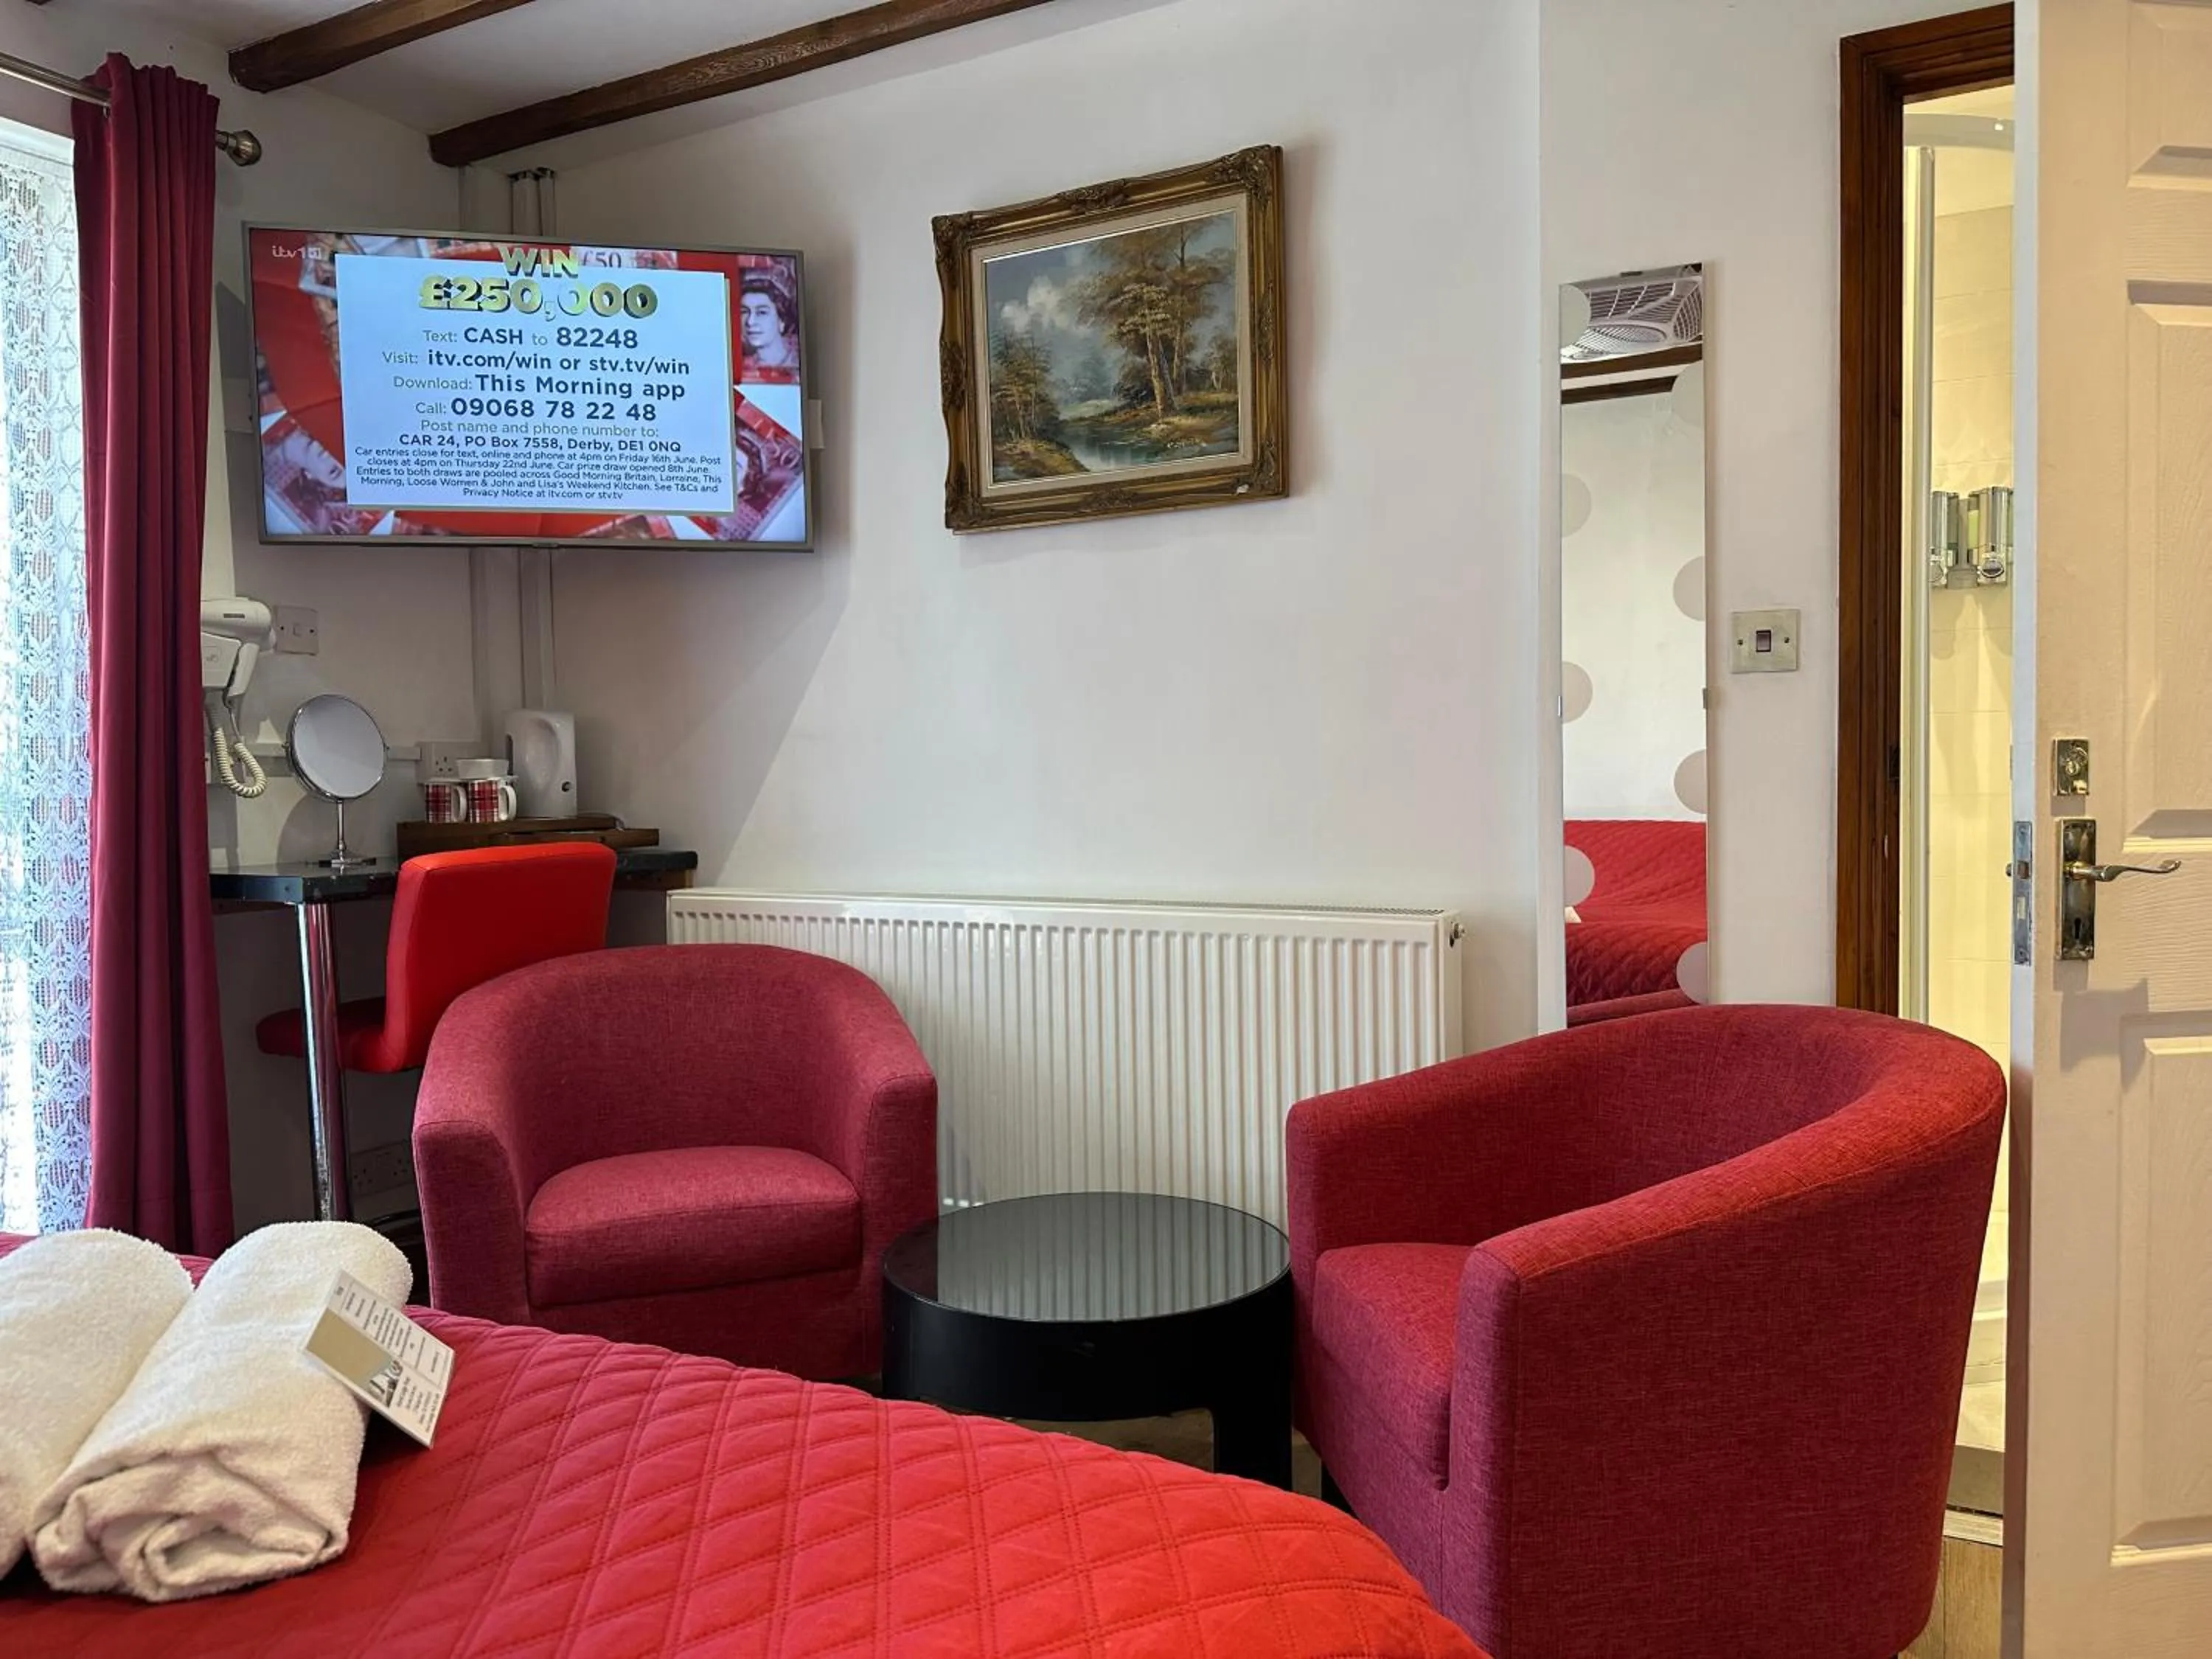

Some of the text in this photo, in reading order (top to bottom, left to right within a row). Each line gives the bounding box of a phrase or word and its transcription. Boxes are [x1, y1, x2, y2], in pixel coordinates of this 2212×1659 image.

[497, 246, 579, 278] WIN
[423, 327, 639, 349] Text: CASH to 82248
[382, 349, 690, 375] Visit: itv.com/win or stv.tv/win
[393, 374, 686, 400] Download: This Morning app
[415, 397, 656, 421] Call: 09068 78 22 48
[421, 420, 659, 437] Post name and phone number to:
[399, 434, 432, 445] CAR
[437, 435, 459, 448] 24,
[465, 436, 486, 447] PO
[490, 437, 518, 448] Box
[523, 437, 563, 451] 7558,
[567, 439, 613, 452] Derby,
[618, 440, 644, 451] DE1
[355, 446, 372, 456] Car
[375, 447, 410, 456] entries
[412, 448, 439, 457] close
[440, 448, 455, 457] for
[481, 450, 511, 459] online
[513, 451, 532, 459] and
[534, 451, 566, 461] phone
[567, 453, 577, 461] at
[580, 453, 602, 462] 4pm
[619, 453, 649, 464] Friday
[700, 456, 720, 465] Post
[366, 456, 399, 466] closes
[400, 458, 411, 467] at
[414, 459, 437, 467] 4pm
[455, 459, 500, 470] Thursday
[502, 459, 527, 469] 22nd
[557, 462, 574, 470] Car
[577, 463, 601, 472] prize
[602, 463, 627, 471] draw
[629, 465, 666, 473] opened
[667, 465, 684, 473] 8th
[356, 466, 392, 476] Entries
[393, 467, 405, 476] to
[407, 467, 431, 476] both
[433, 468, 462, 477] draws
[483, 470, 517, 480] pooled
[553, 470, 580, 479] Good
[582, 472, 622, 481] Morning
[703, 475, 722, 484] This
[361, 476, 405, 487] Morning,
[408, 477, 437, 486] Loose
[439, 478, 479, 487] Women
[490, 479, 515, 487] John
[517, 479, 536, 487] and
[566, 481, 611, 490] Weekend
[654, 483, 672, 491] See
[675, 483, 698, 492] T&Cs
[700, 484, 719, 493] and
[462, 487, 499, 498] Privacy
[501, 489, 533, 498] Notice
[535, 490, 546, 498] at
[585, 491, 596, 499] or
